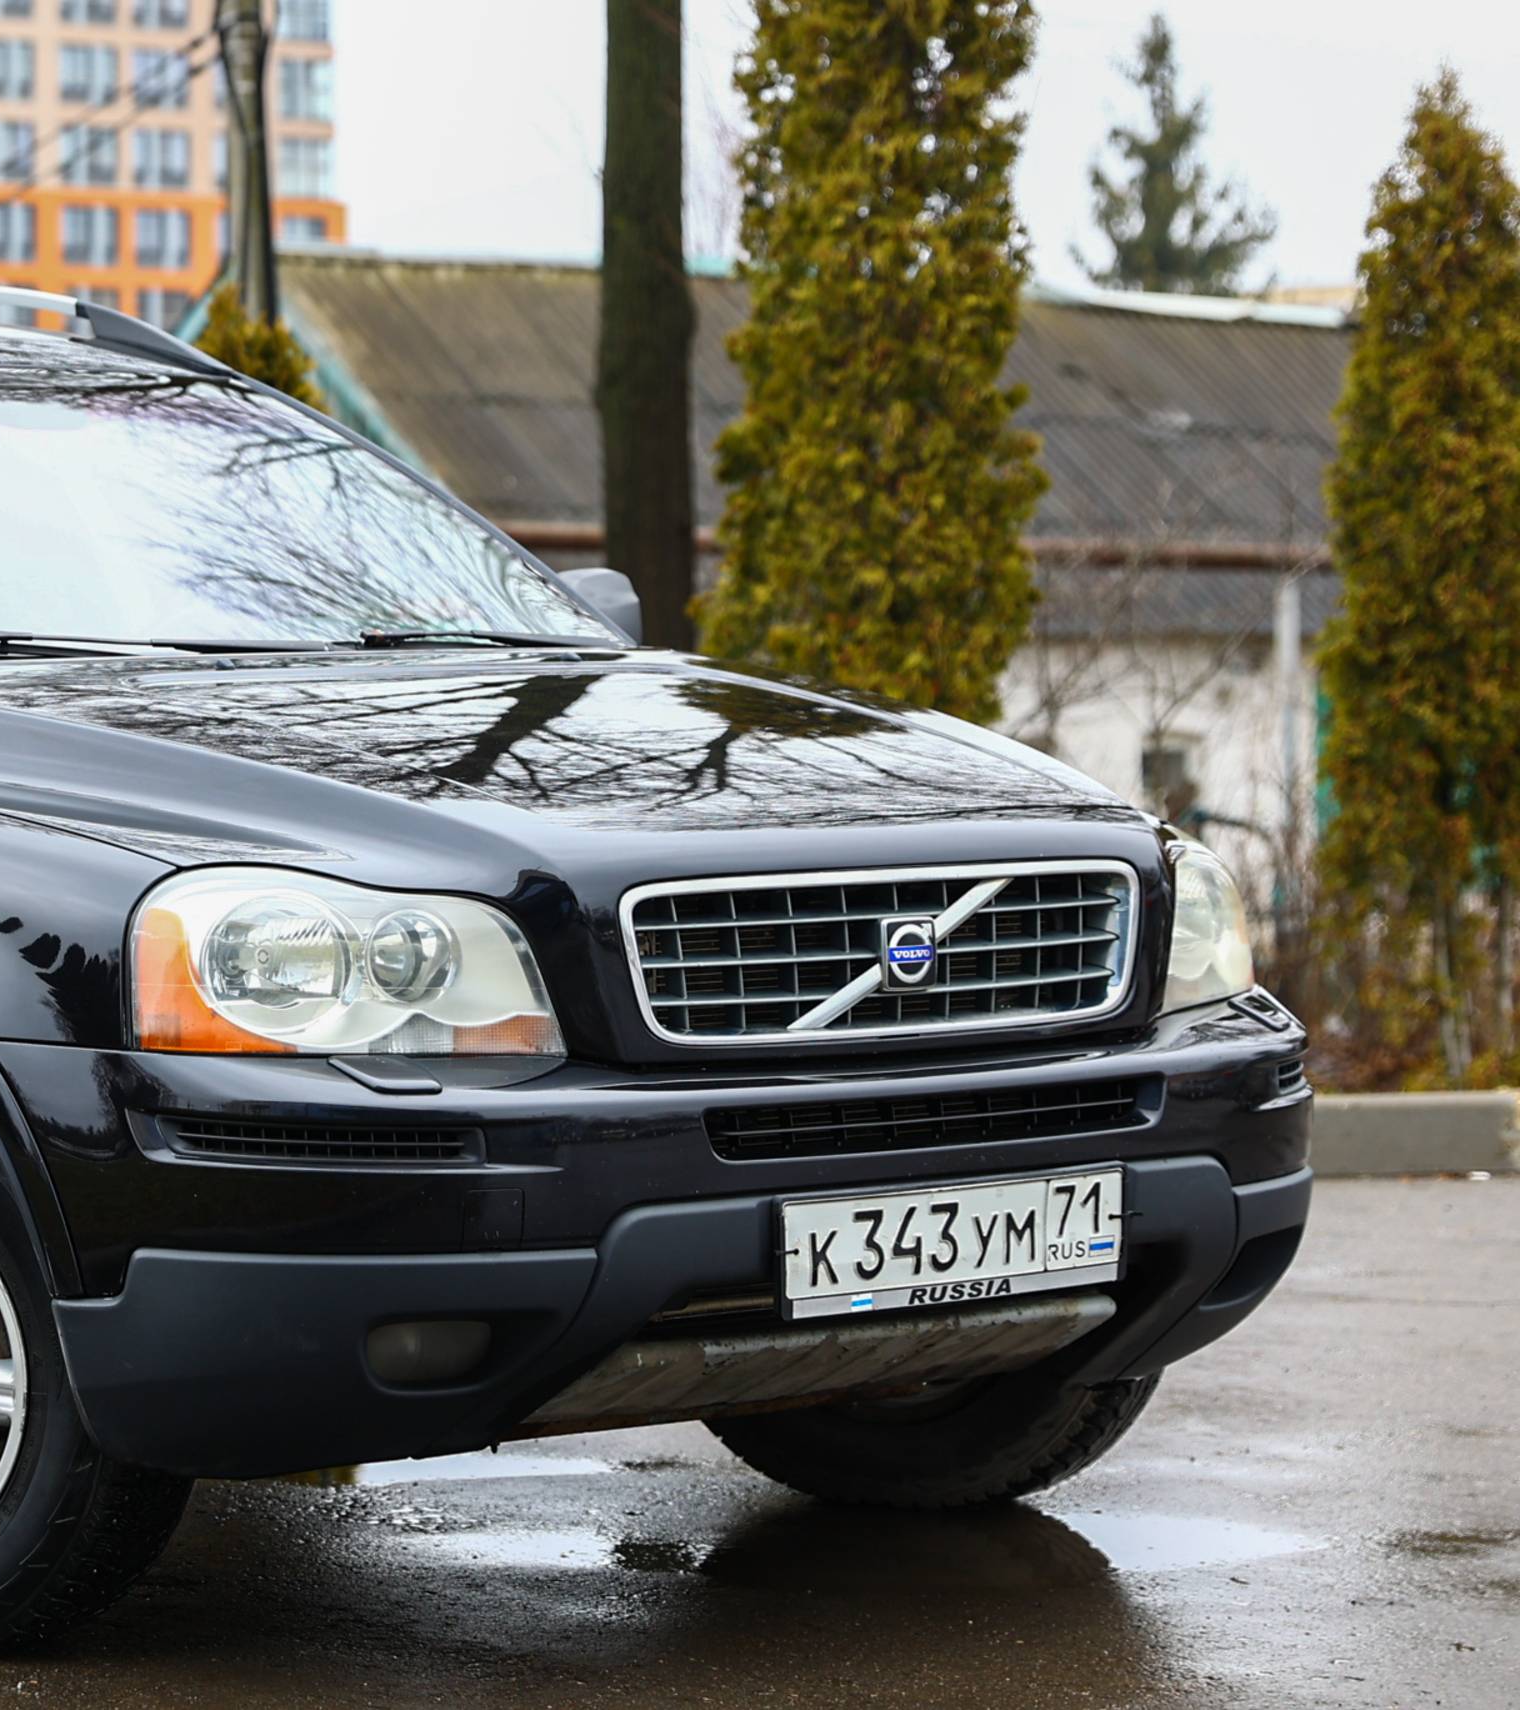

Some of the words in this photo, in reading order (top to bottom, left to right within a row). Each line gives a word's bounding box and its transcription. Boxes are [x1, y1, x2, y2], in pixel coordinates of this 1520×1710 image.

[892, 949, 930, 959] VOLVO
[1053, 1181, 1102, 1239] 71
[1047, 1240, 1086, 1262] RUS
[907, 1277, 1013, 1306] RUSSIA
